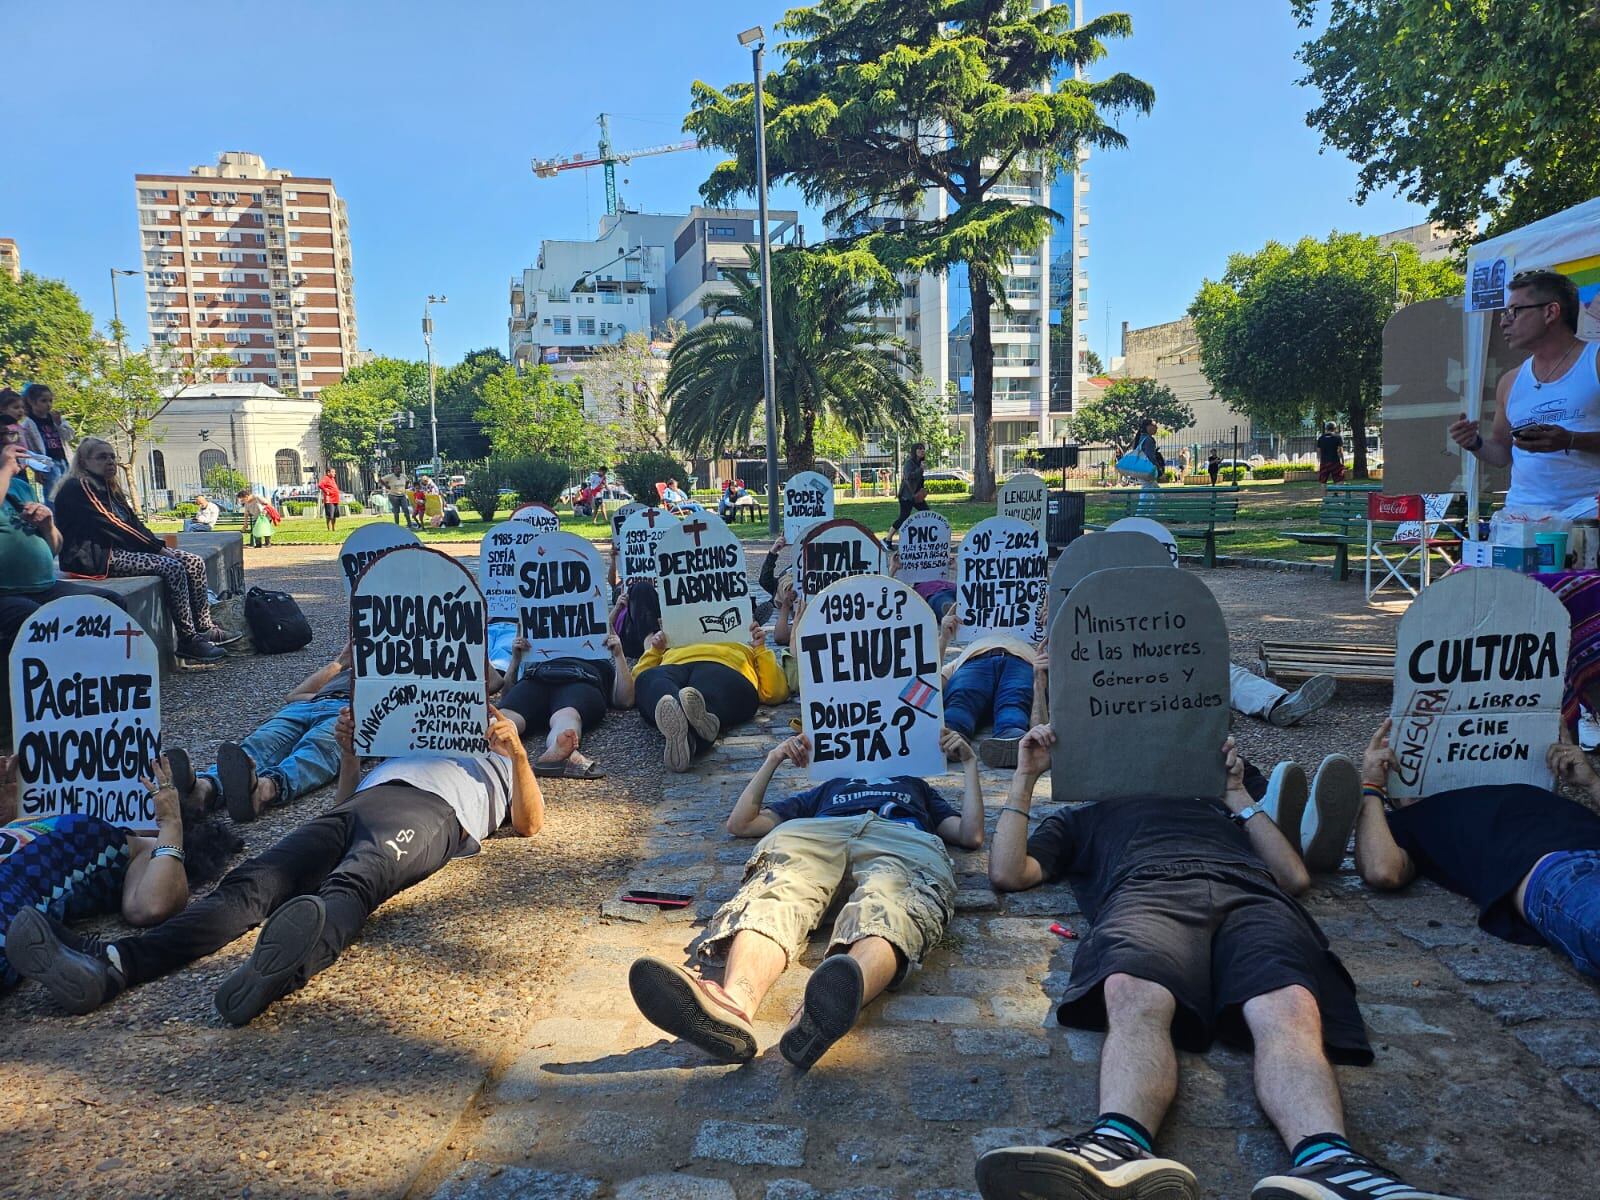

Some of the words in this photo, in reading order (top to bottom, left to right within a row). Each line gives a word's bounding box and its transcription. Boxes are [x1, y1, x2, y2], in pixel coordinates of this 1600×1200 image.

[787, 489, 824, 505] PODER
[787, 505, 826, 517] JUDICIAL
[1005, 489, 1042, 504] LENGUAJE
[625, 543, 645, 555] JUAN
[908, 526, 938, 544] PNC
[488, 547, 516, 563] SOFÍA
[659, 544, 738, 576] DERECHOS
[964, 551, 1048, 581] PREVENCIÓN
[519, 561, 591, 599] SALUD
[663, 571, 748, 606] LABORALES
[961, 580, 1038, 609] VIH-TBC
[75, 614, 111, 638] 2024
[352, 586, 484, 644] EDUCACIÓN
[520, 602, 607, 639] MENTAL
[725, 616, 735, 628] 49
[355, 636, 477, 681] PÚBLICA
[801, 624, 937, 684] TEHUEL
[1071, 641, 1090, 661] de
[1098, 640, 1122, 660] las
[1409, 631, 1560, 684] CULTURA
[1093, 667, 1169, 687] Géneros
[810, 697, 881, 730] DÓNDE
[1090, 693, 1223, 717] Diversidades
[1400, 689, 1449, 787] CENSURA
